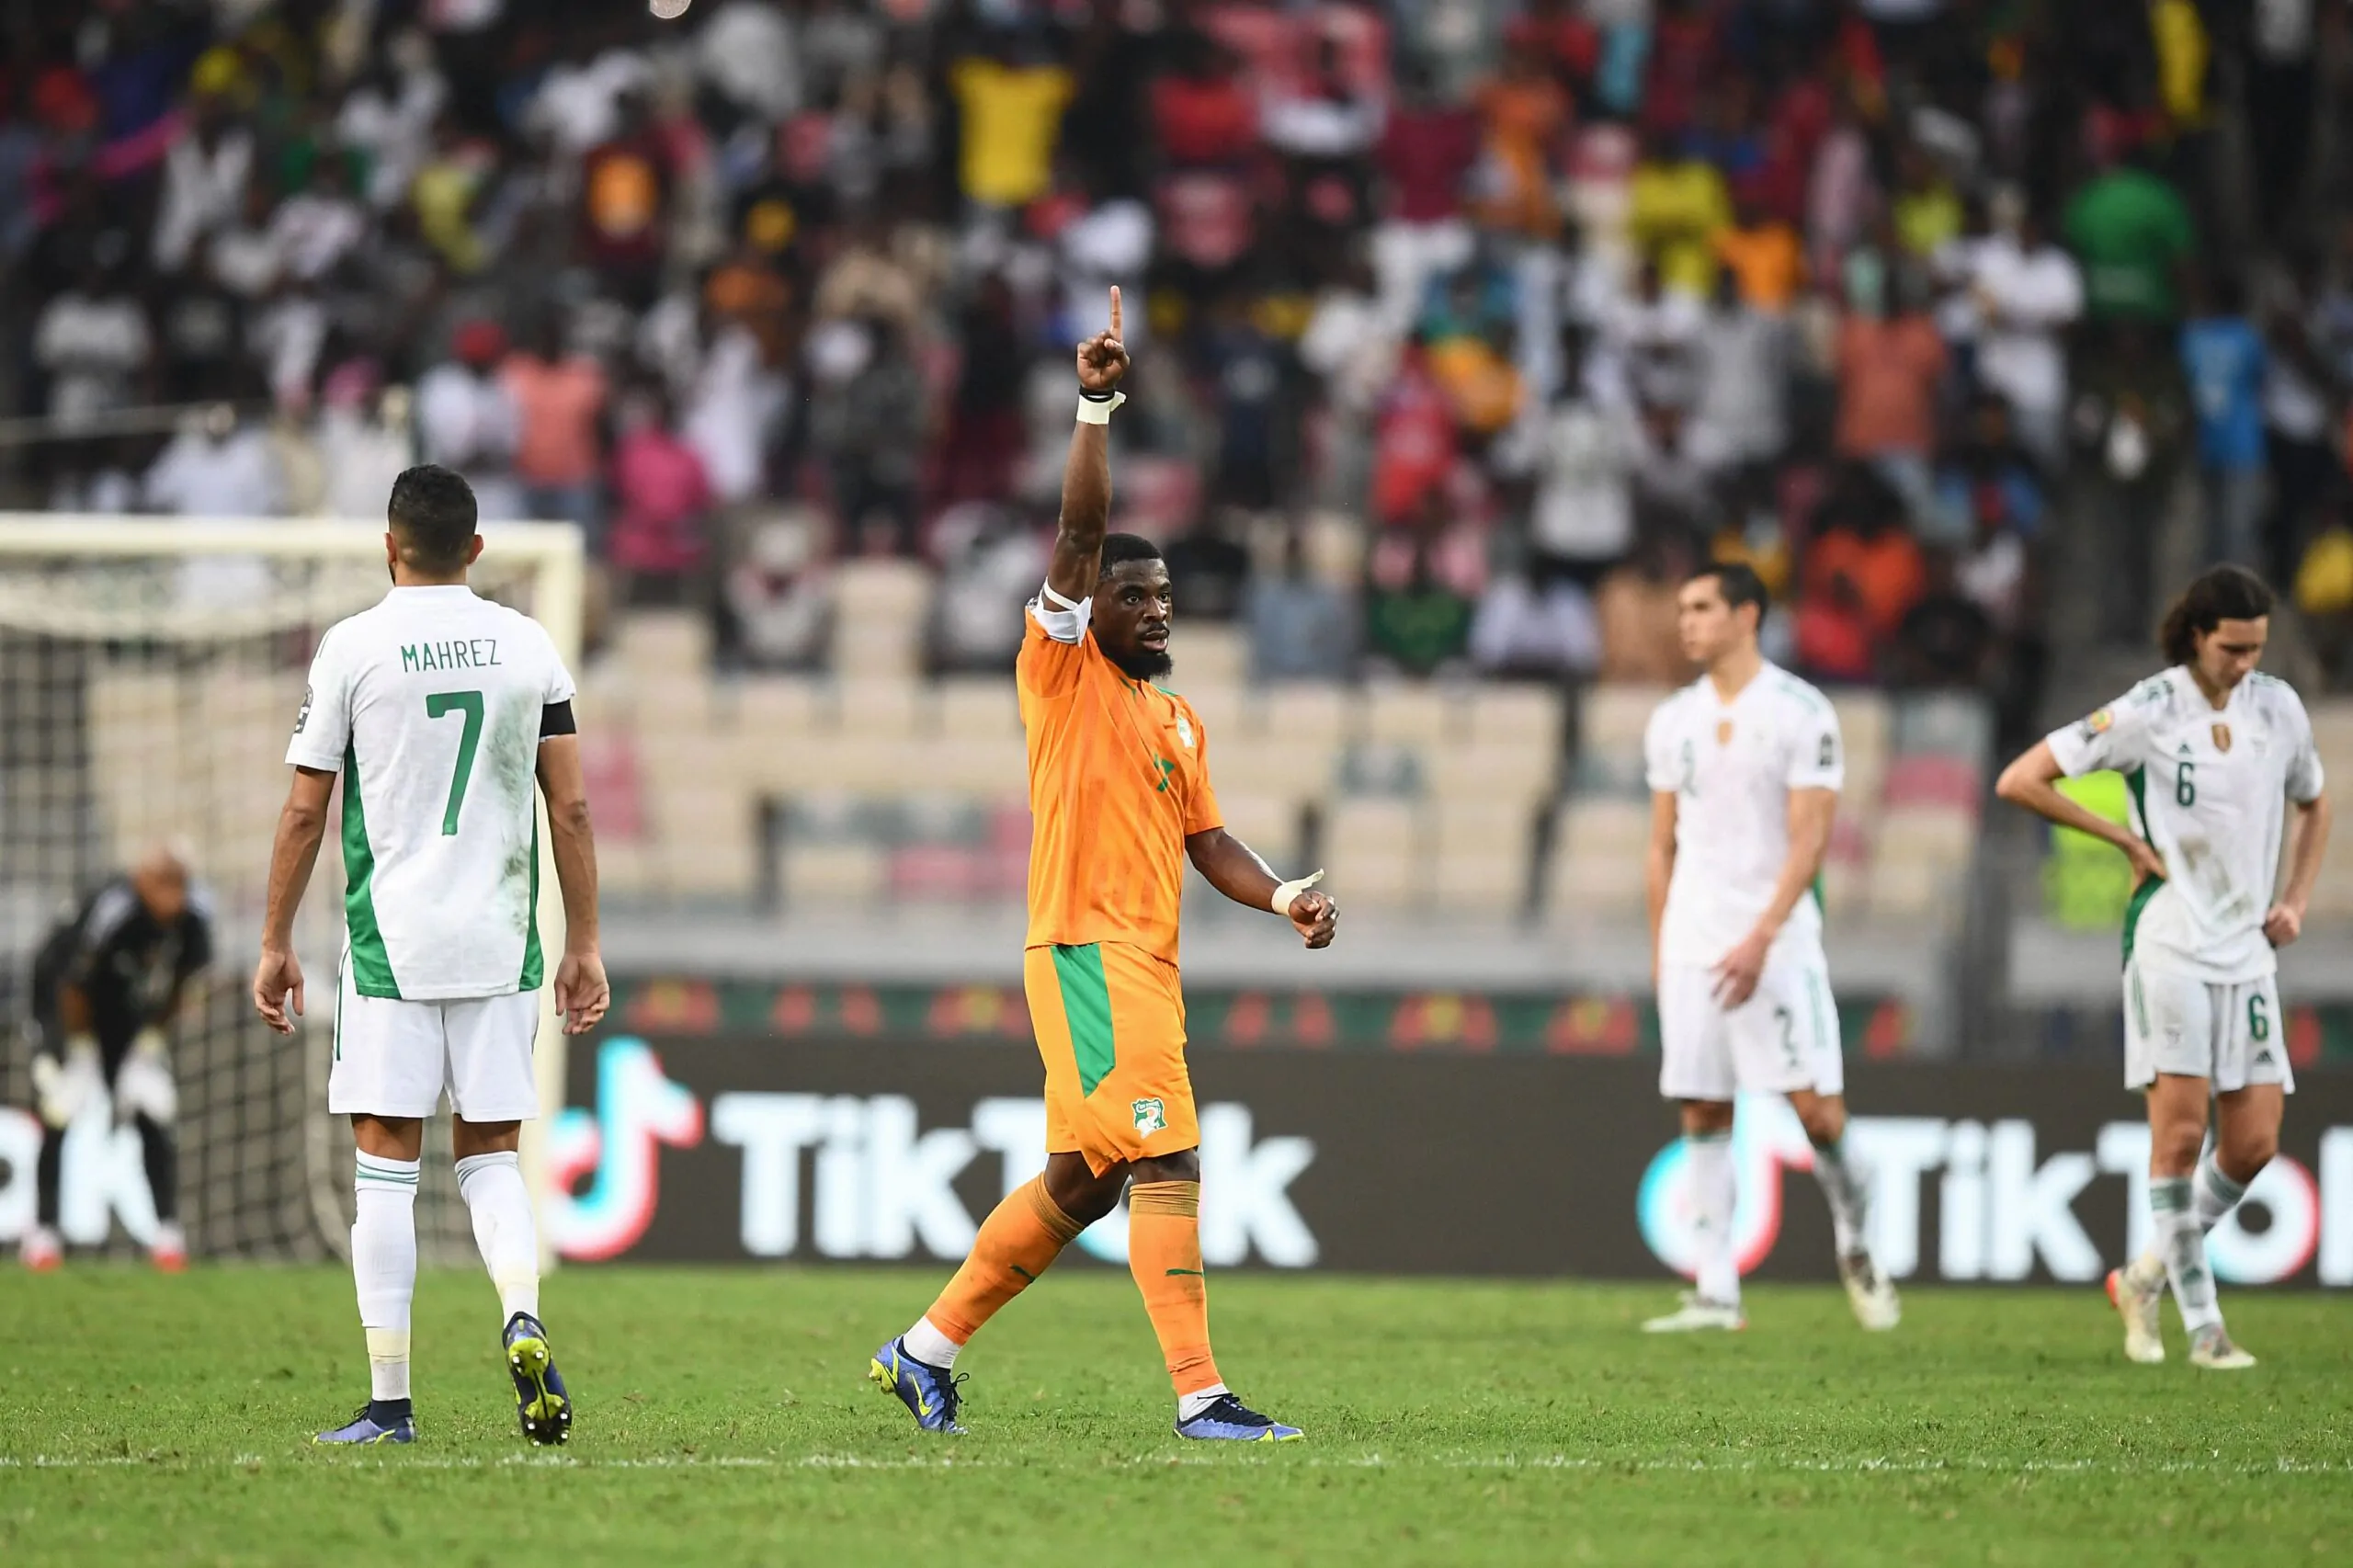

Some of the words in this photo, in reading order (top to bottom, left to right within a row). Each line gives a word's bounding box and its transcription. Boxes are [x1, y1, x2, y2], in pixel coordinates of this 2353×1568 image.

[400, 639, 502, 673] MAHREZ
[426, 690, 484, 835] 7
[2177, 762, 2195, 807] 6
[2247, 994, 2269, 1042] 6
[710, 1092, 1319, 1267] TikTk
